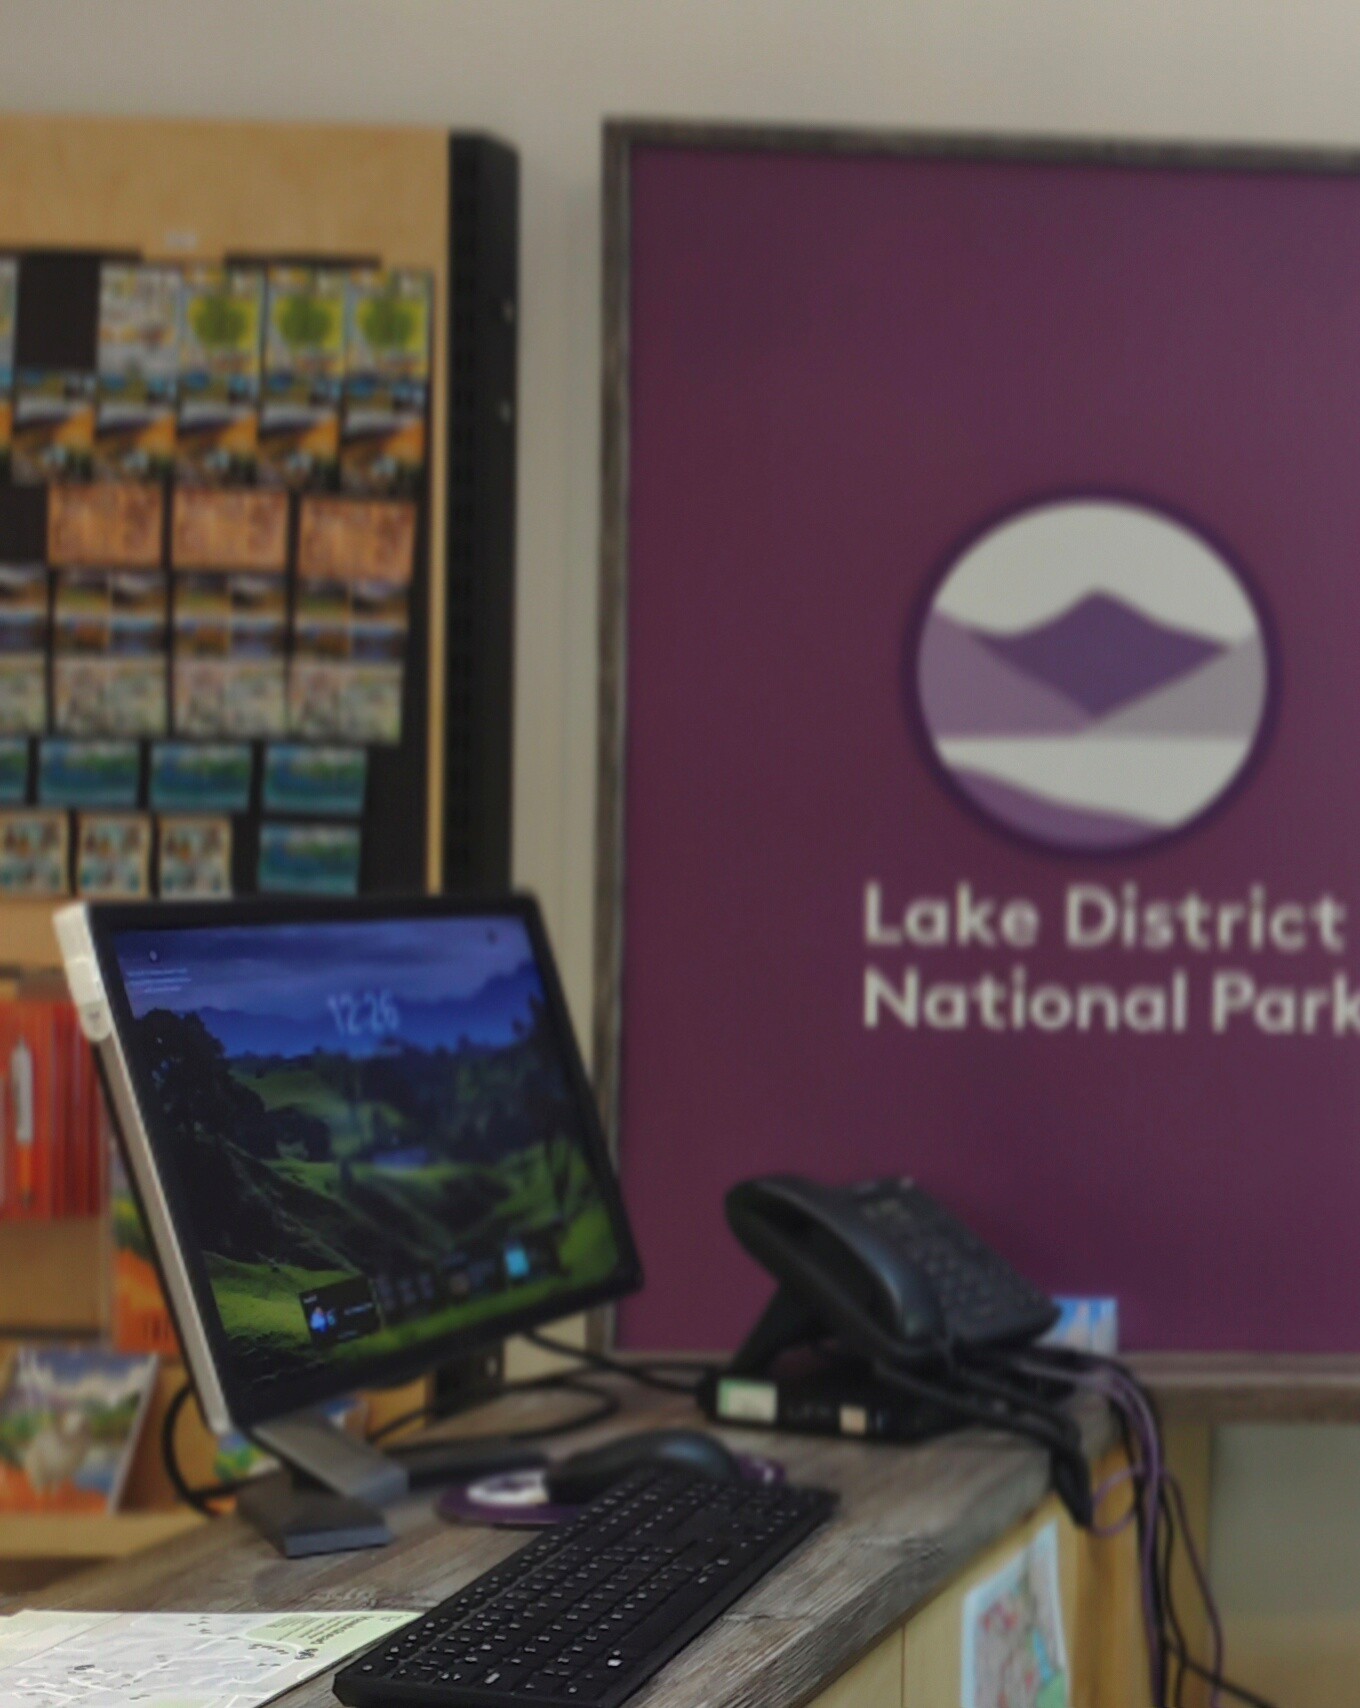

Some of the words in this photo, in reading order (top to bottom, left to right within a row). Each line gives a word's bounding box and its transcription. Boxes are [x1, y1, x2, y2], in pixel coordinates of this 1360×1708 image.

[864, 878, 1041, 948] Lake
[1063, 880, 1348, 953] District
[862, 964, 1190, 1032] National
